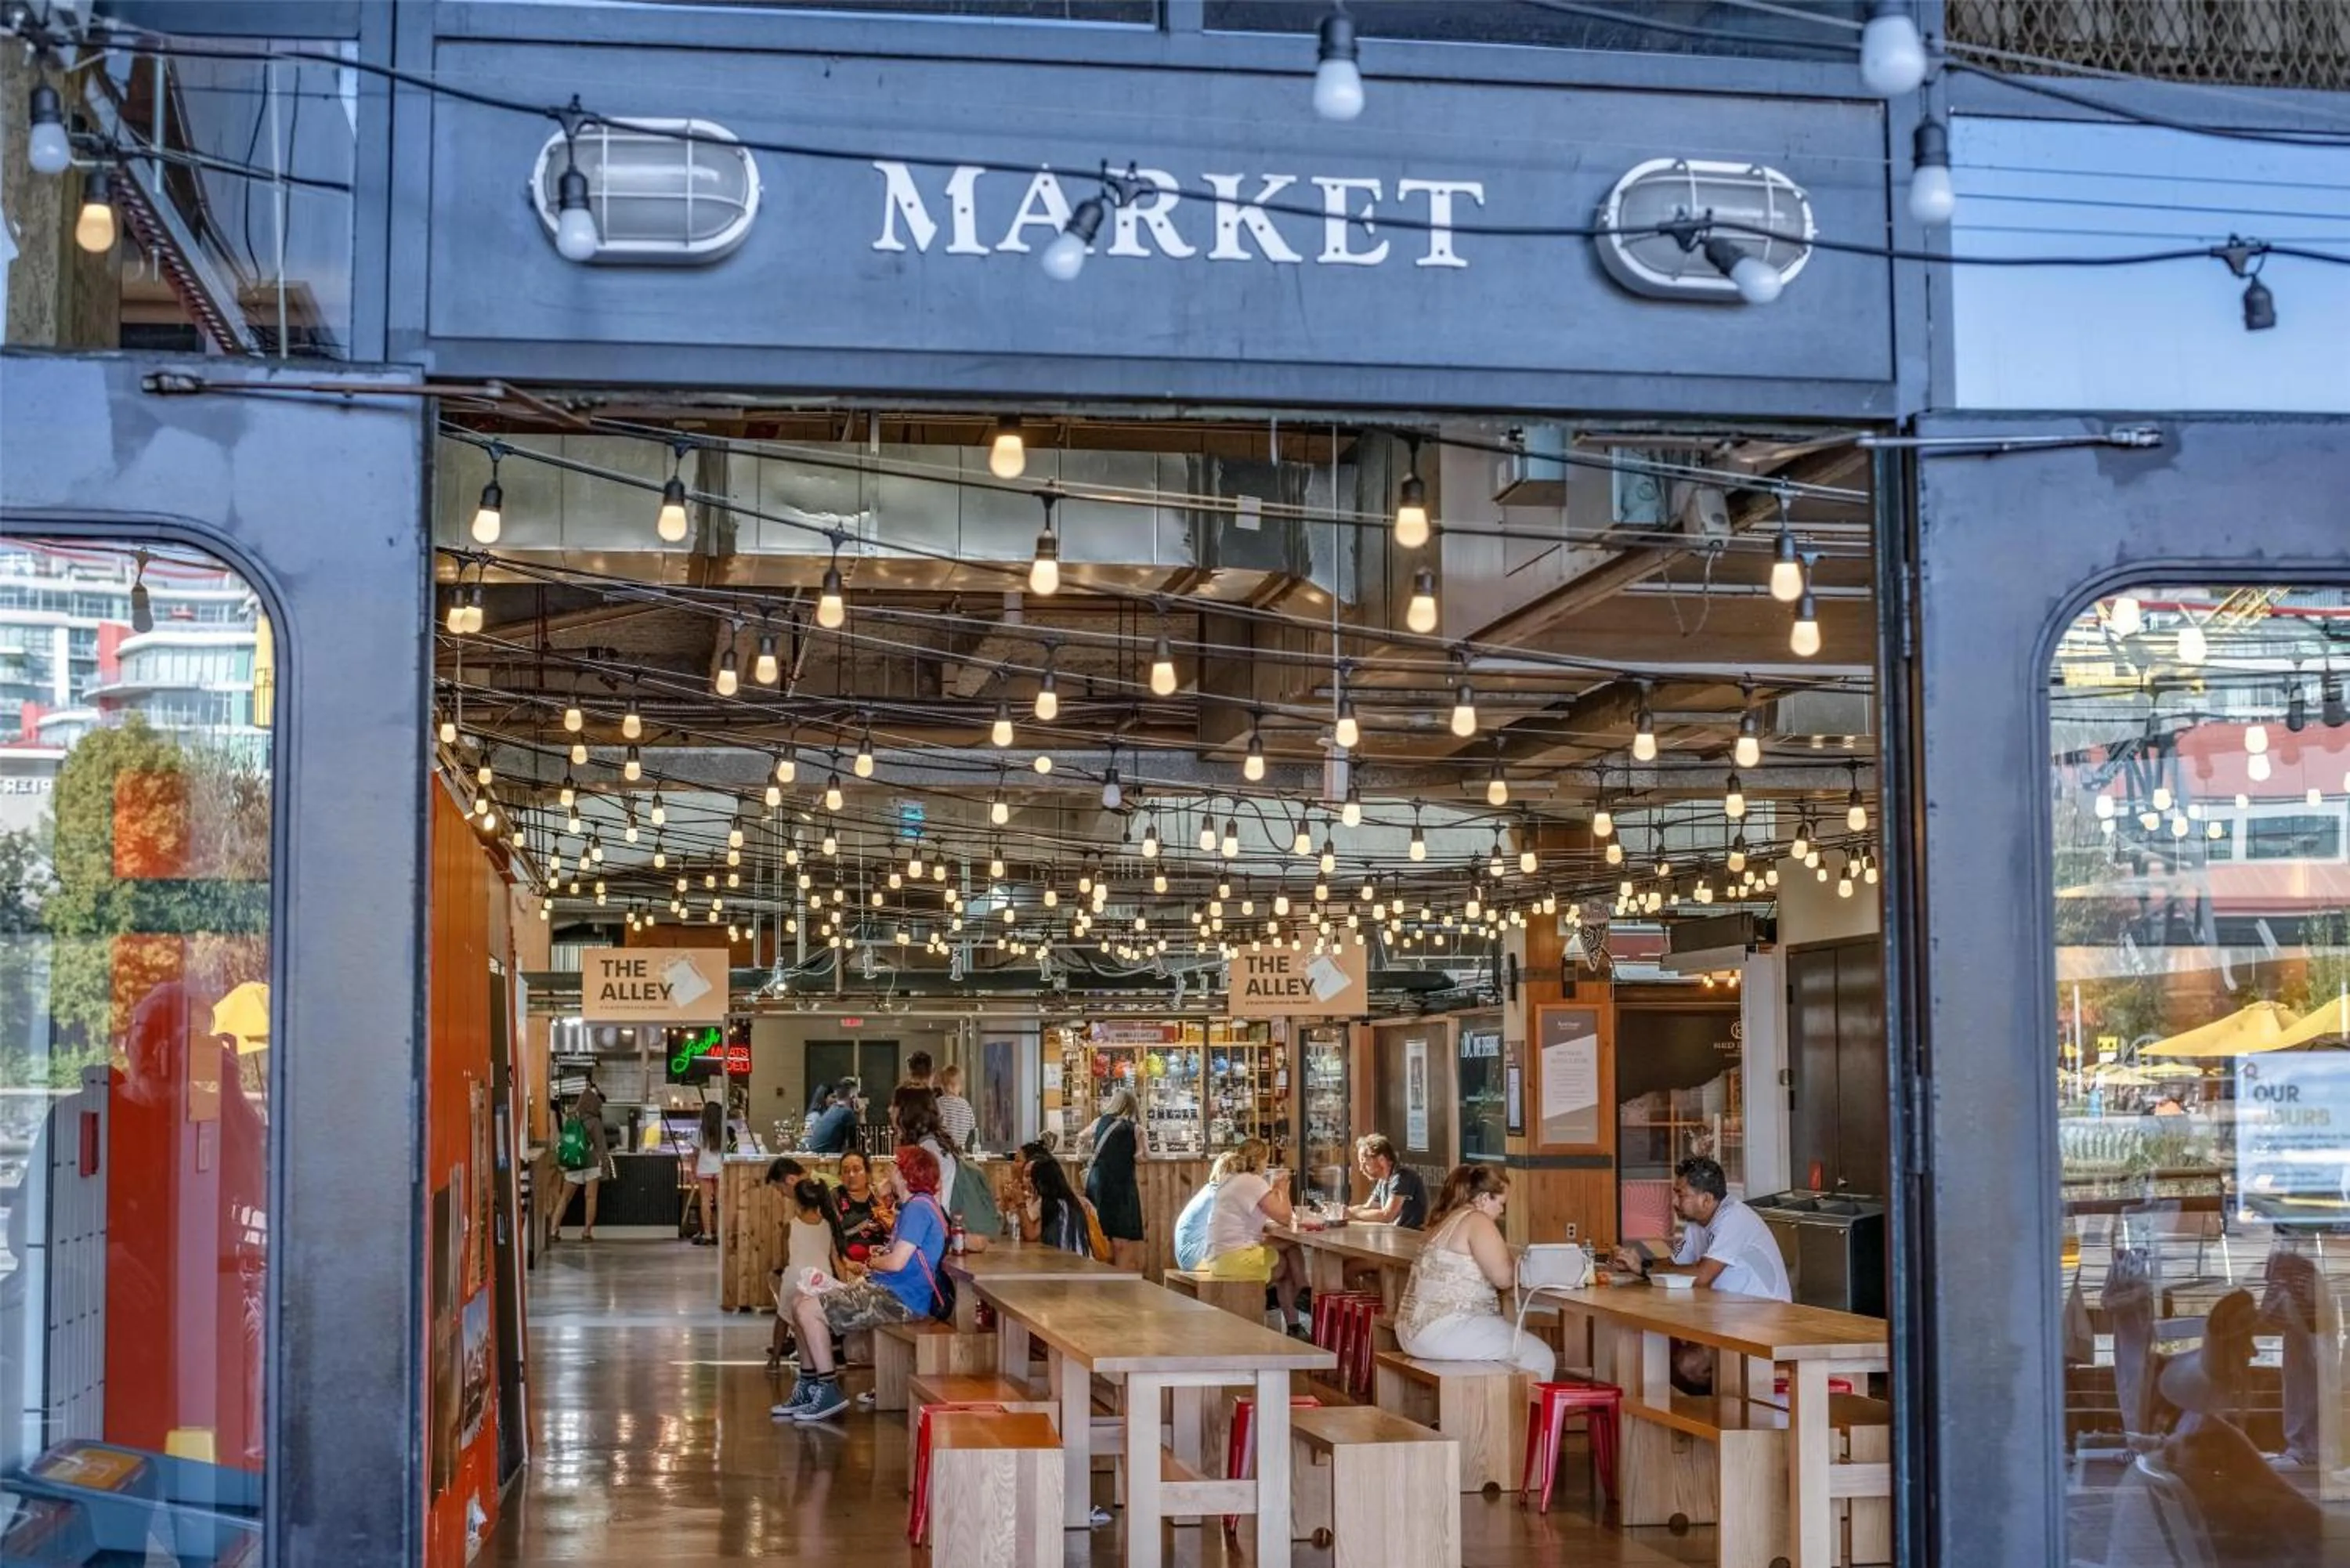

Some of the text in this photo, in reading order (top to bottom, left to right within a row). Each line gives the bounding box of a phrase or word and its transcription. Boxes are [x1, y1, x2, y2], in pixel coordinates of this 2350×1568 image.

[873, 161, 1484, 267] MARKET
[601, 959, 648, 977] THE
[1246, 956, 1290, 974] THE
[600, 983, 674, 1000] ALLEY
[1246, 978, 1316, 995] ALLEY
[710, 1045, 750, 1058] MATS
[2254, 1085, 2300, 1103] OUR
[2254, 1107, 2331, 1126] OURS
